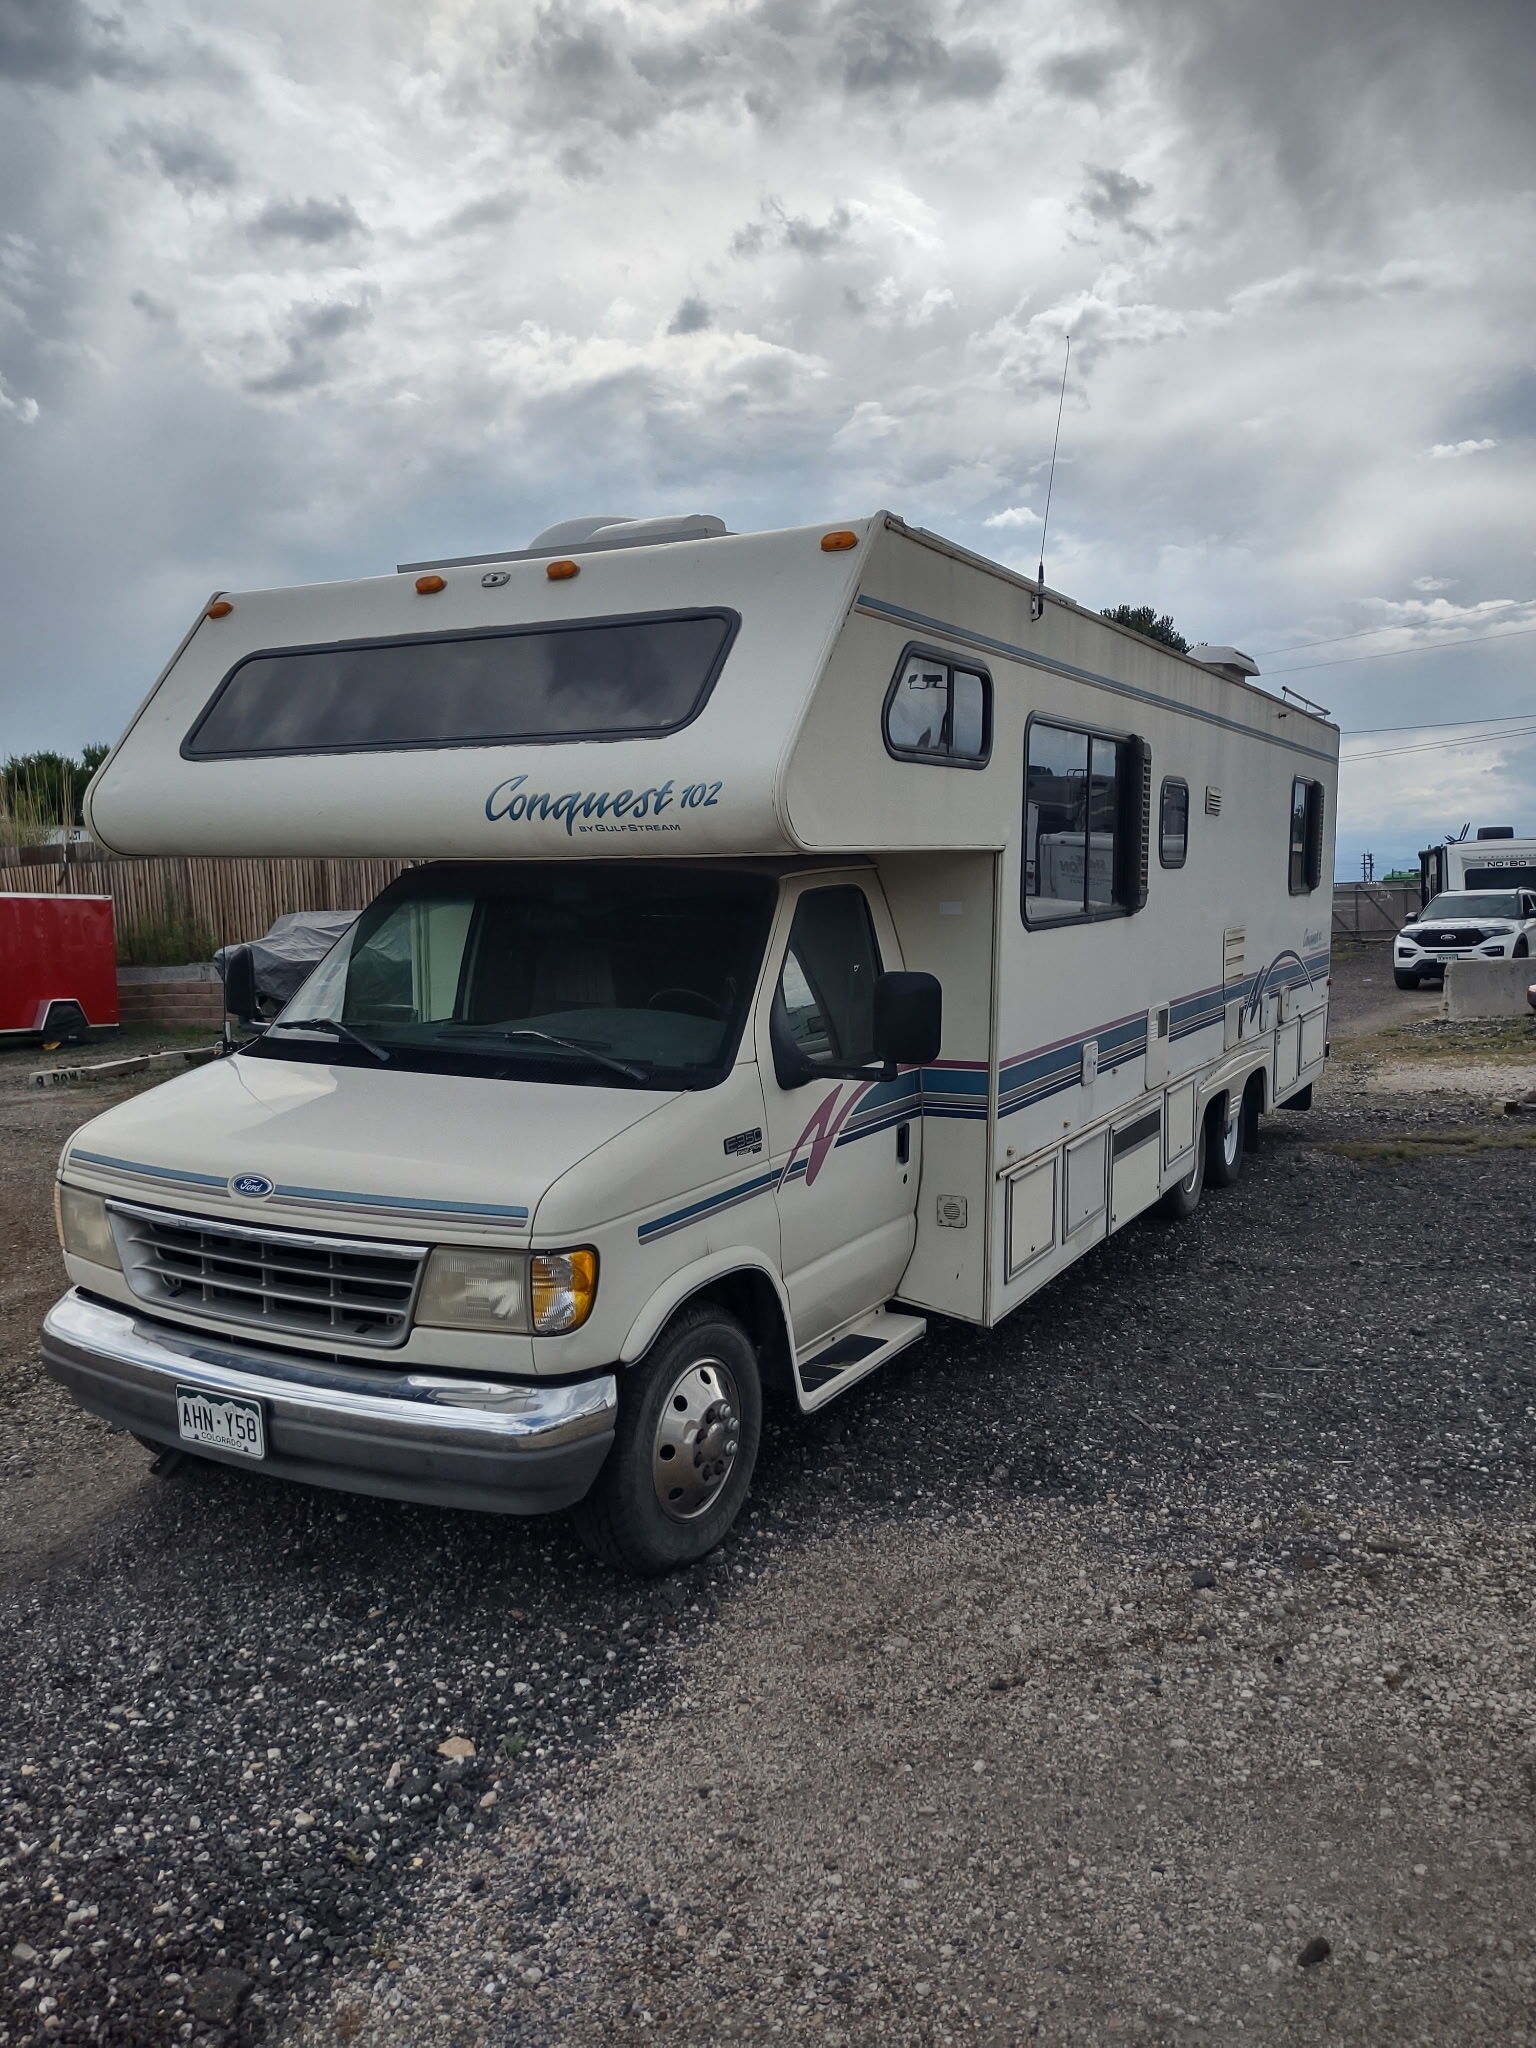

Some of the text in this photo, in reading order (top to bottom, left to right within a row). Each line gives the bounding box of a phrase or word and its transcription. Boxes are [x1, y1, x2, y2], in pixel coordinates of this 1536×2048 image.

[485, 774, 724, 837] Conquest 102
[578, 823, 682, 833] BY GULFSTREAM
[725, 1129, 762, 1154] E350
[240, 1178, 263, 1192] Ford
[201, 1431, 243, 1448] COLORADO
